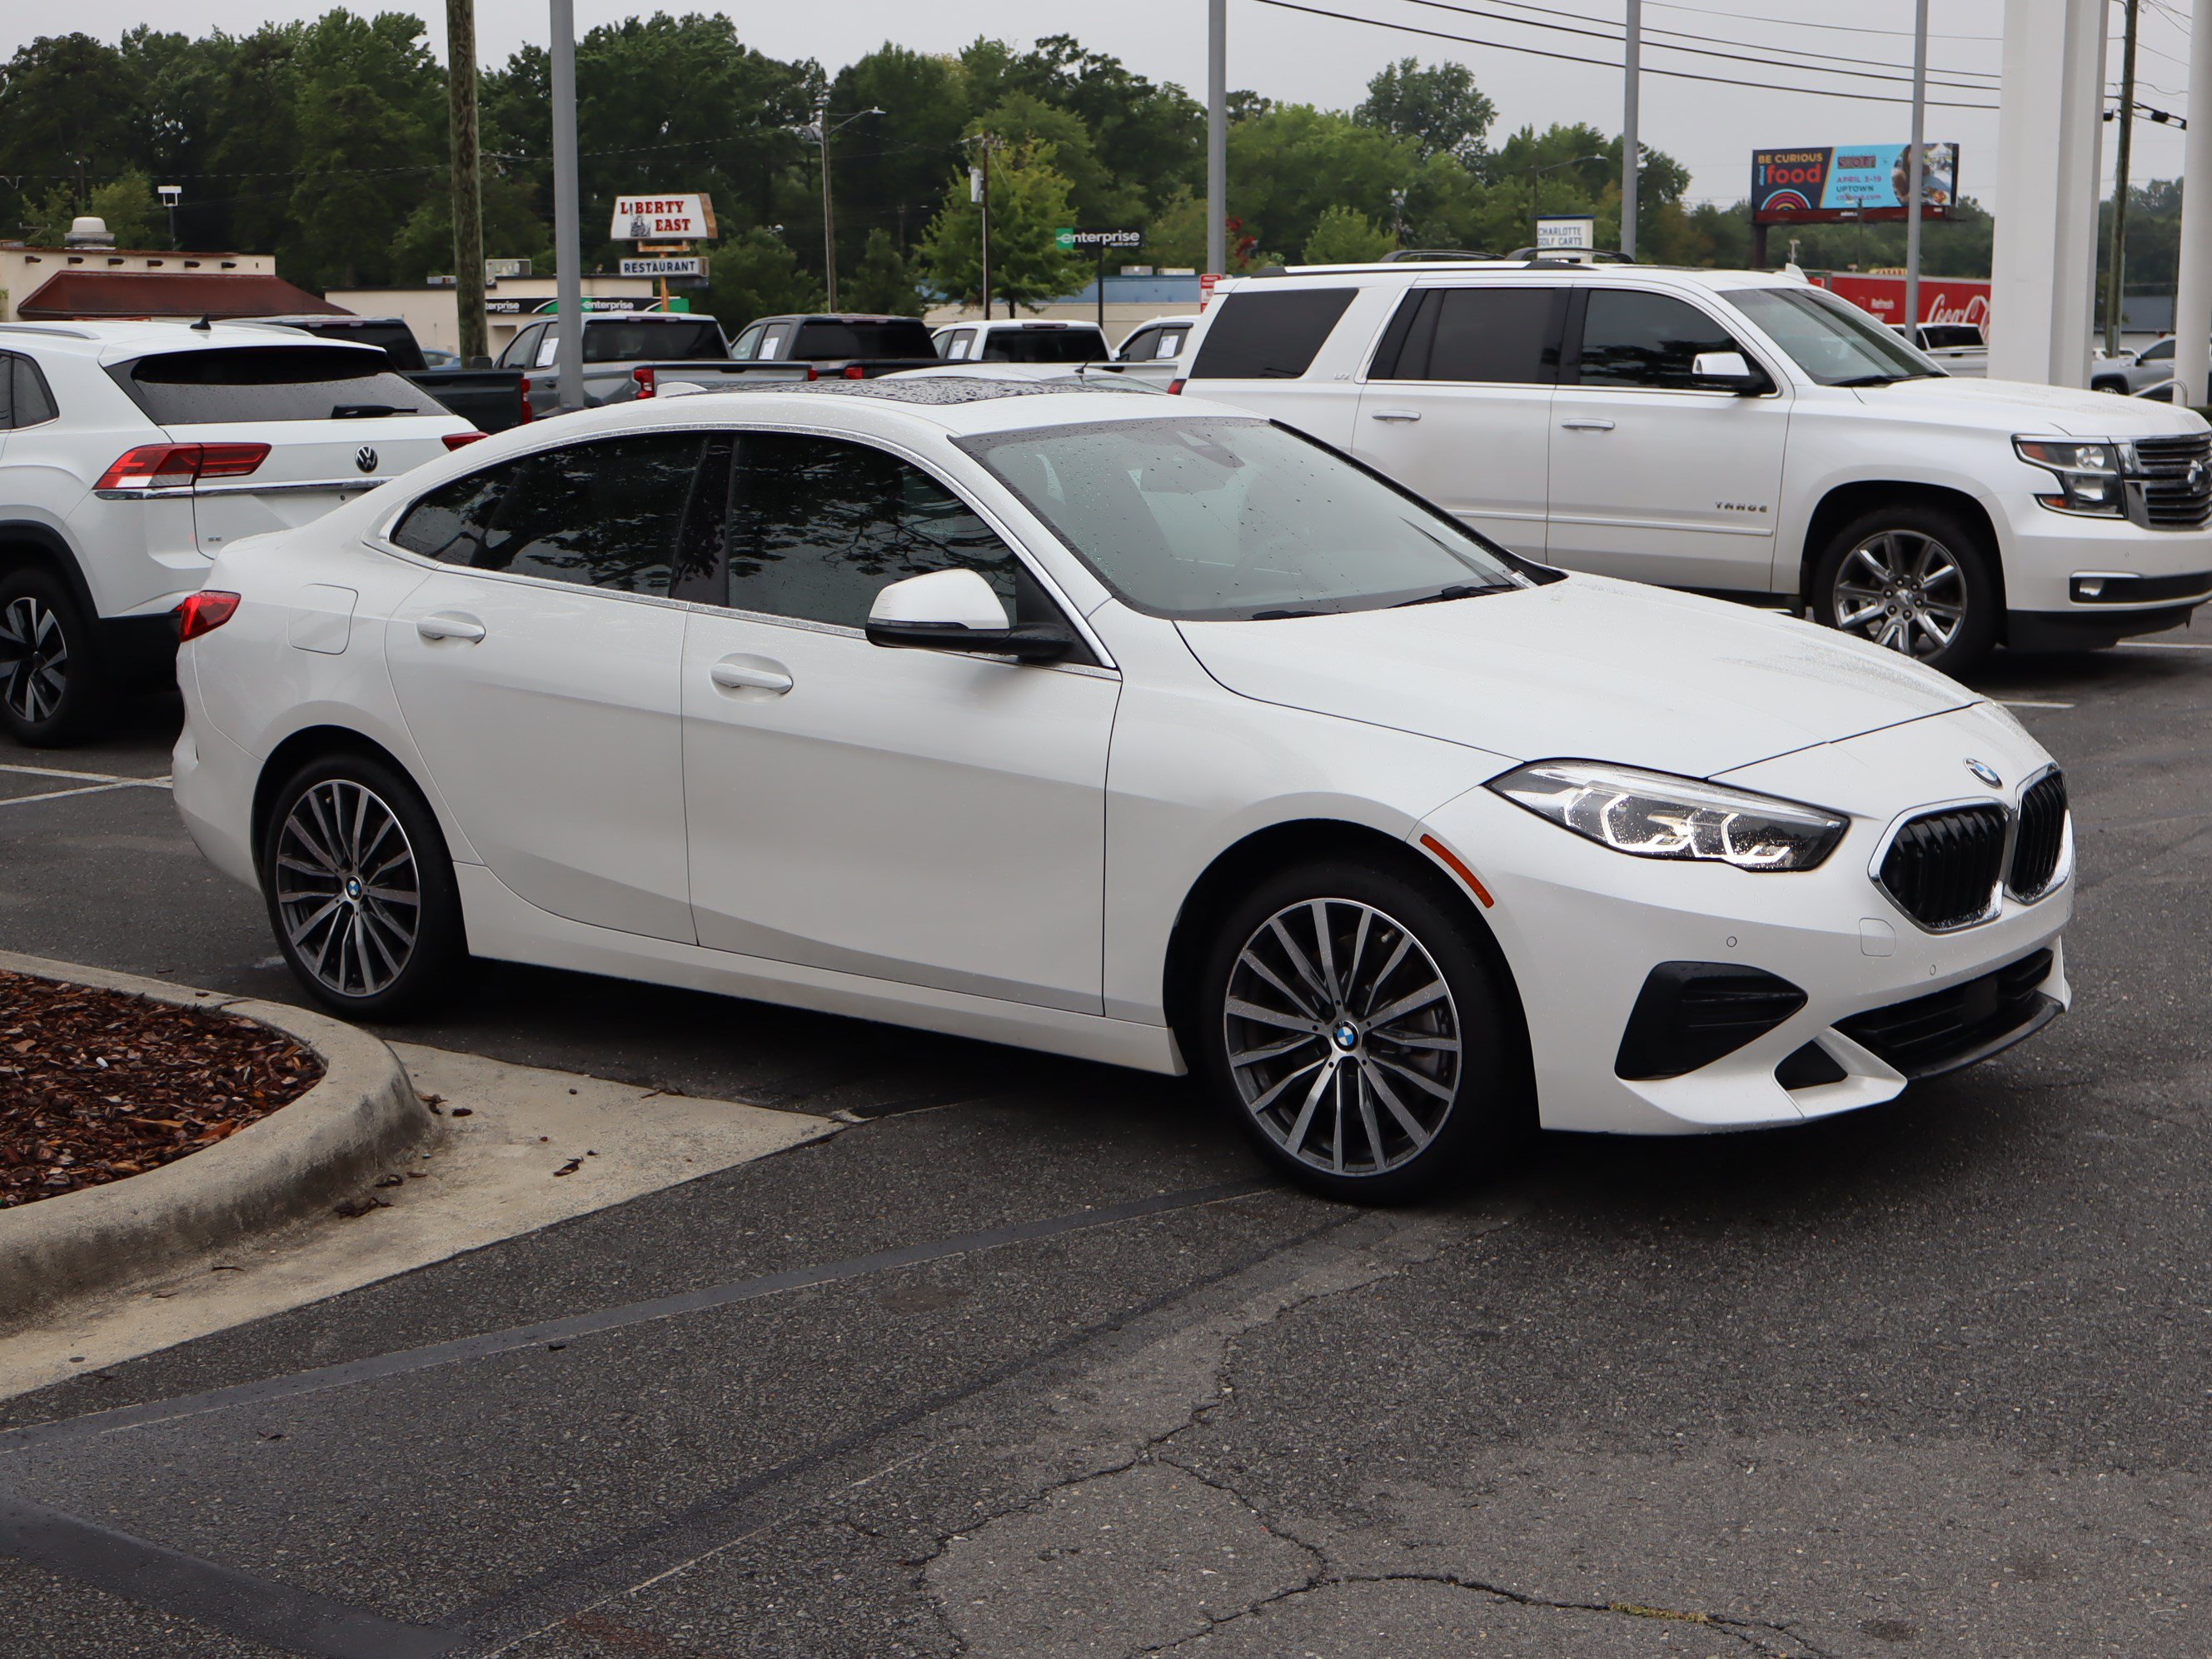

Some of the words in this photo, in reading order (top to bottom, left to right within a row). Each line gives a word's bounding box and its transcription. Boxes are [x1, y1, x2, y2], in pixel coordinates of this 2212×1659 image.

[1758, 154, 1772, 164] BE
[1775, 152, 1823, 163] CURIOUS
[1766, 162, 1821, 185] food
[1836, 175, 1861, 183] APRIL
[1836, 184, 1874, 193] UPTOWN
[655, 218, 690, 232] EAST
[1058, 230, 1140, 245] enterprise
[1538, 227, 1582, 236] CHARLOTTE
[1558, 237, 1582, 246] CARTS
[624, 260, 696, 273] RESTAURANT
[584, 300, 635, 311] enterprise
[1715, 501, 1767, 513] TAHOE
